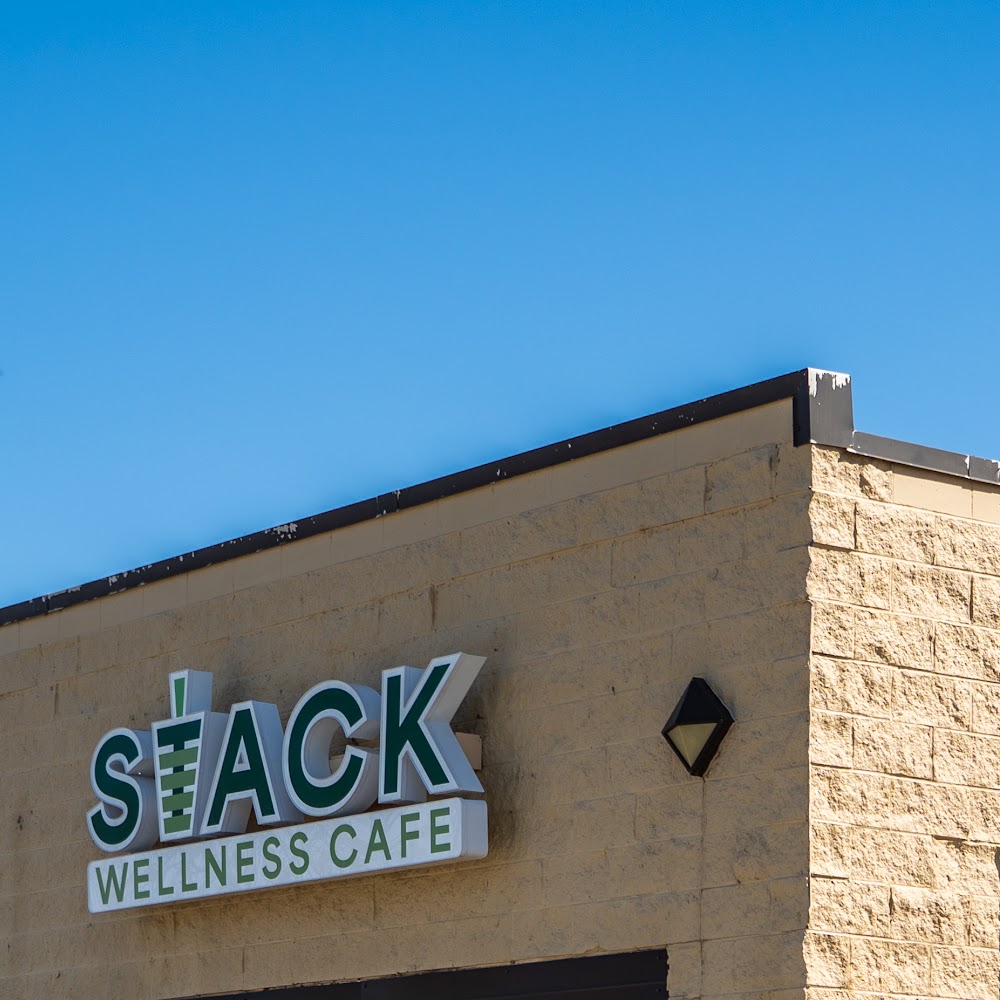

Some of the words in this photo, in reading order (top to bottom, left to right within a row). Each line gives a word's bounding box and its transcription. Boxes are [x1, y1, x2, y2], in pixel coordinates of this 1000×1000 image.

[88, 660, 456, 849] STACK
[95, 831, 310, 905] WELLNESS
[329, 806, 452, 869] CAFE
